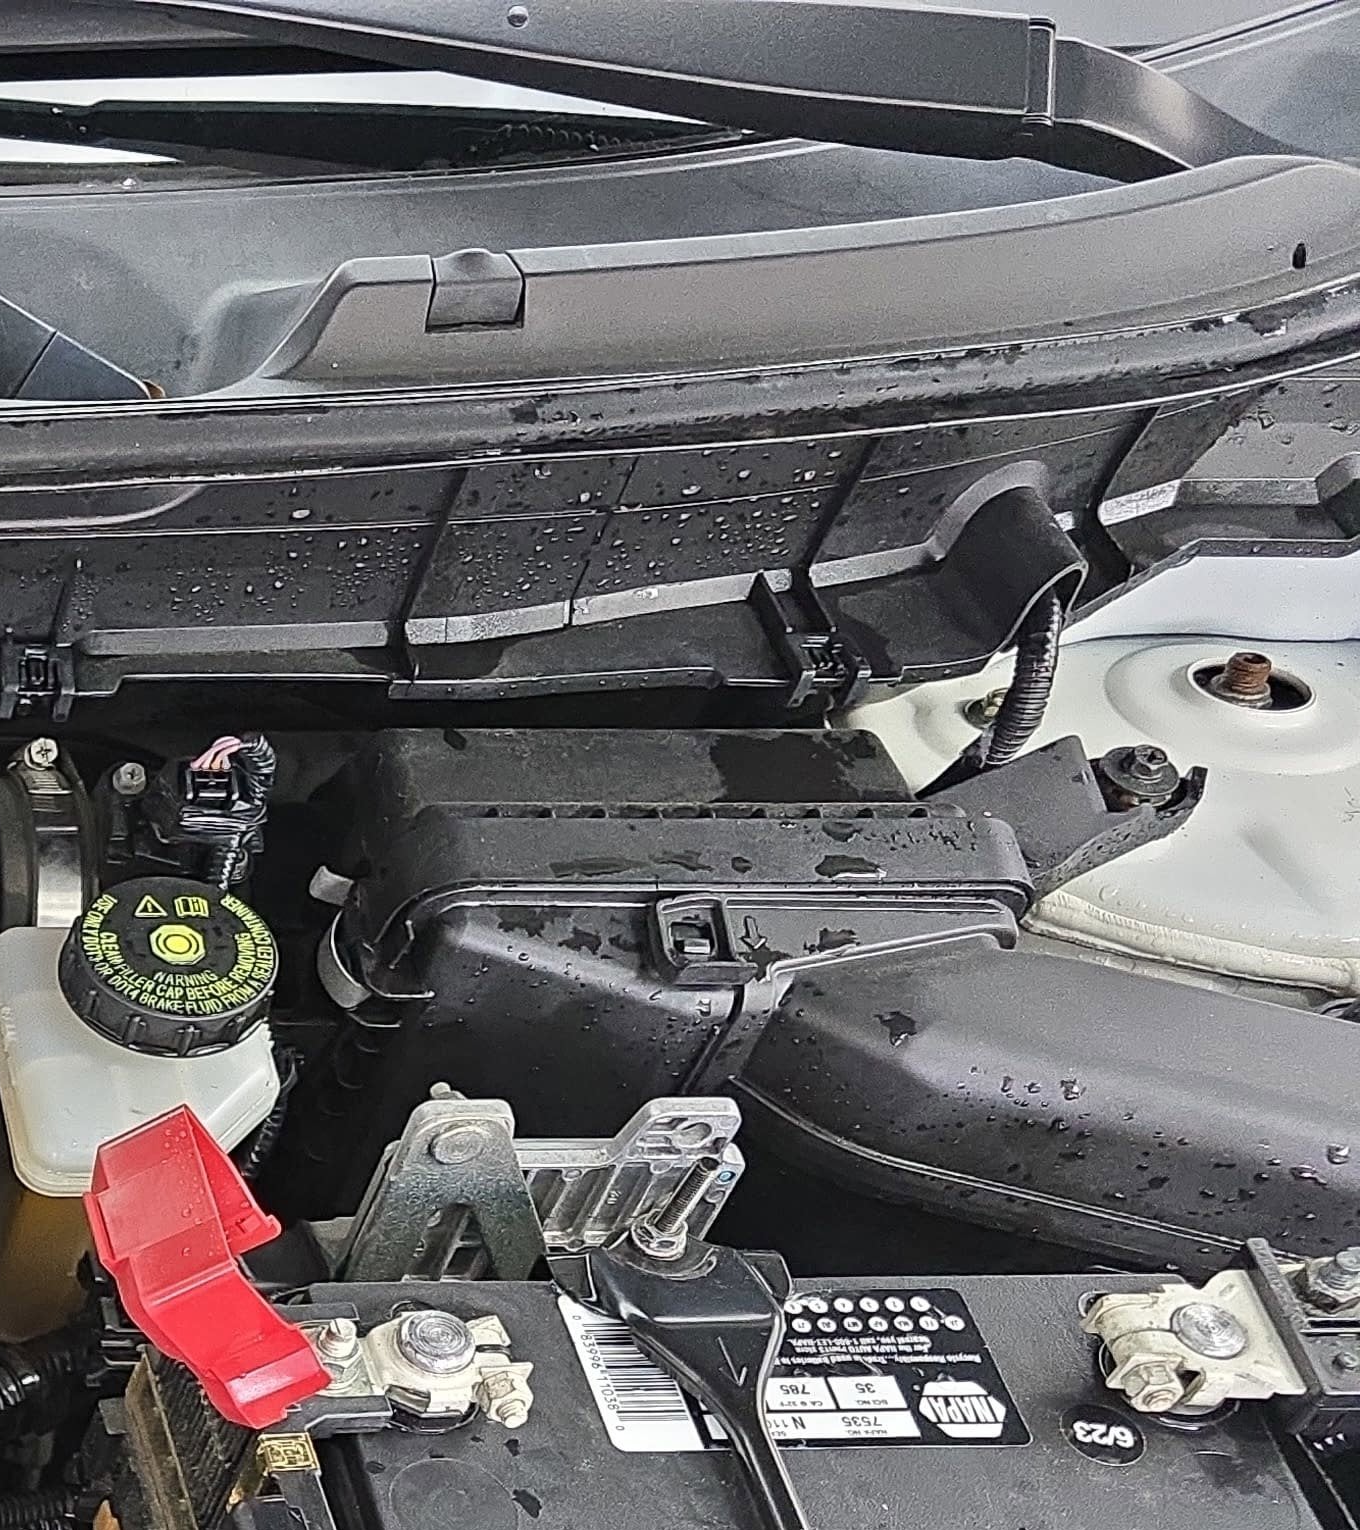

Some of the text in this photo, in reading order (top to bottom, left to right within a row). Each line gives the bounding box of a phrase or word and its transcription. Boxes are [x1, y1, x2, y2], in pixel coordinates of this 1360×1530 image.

[92, 895, 118, 914] USE
[220, 895, 271, 946] CONTAINER
[94, 961, 111, 977] OR
[156, 985, 184, 999] CAP
[186, 978, 234, 1000] BEFORE
[230, 932, 256, 983] REMOVING
[255, 945, 274, 982] SEALED
[154, 970, 219, 986] WARNING
[139, 991, 184, 1012] BRAKE
[185, 999, 223, 1015] FLUID
[223, 985, 256, 1008] FROM
[581, 1335, 601, 1369] 83996
[596, 1376, 620, 1411] 11038
[780, 1384, 809, 1395] 785
[855, 1383, 875, 1393] 35
[933, 1396, 990, 1423] NAPA
[792, 1416, 806, 1429] N
[841, 1416, 881, 1426] 7535
[1072, 1421, 1135, 1448] 6/23
